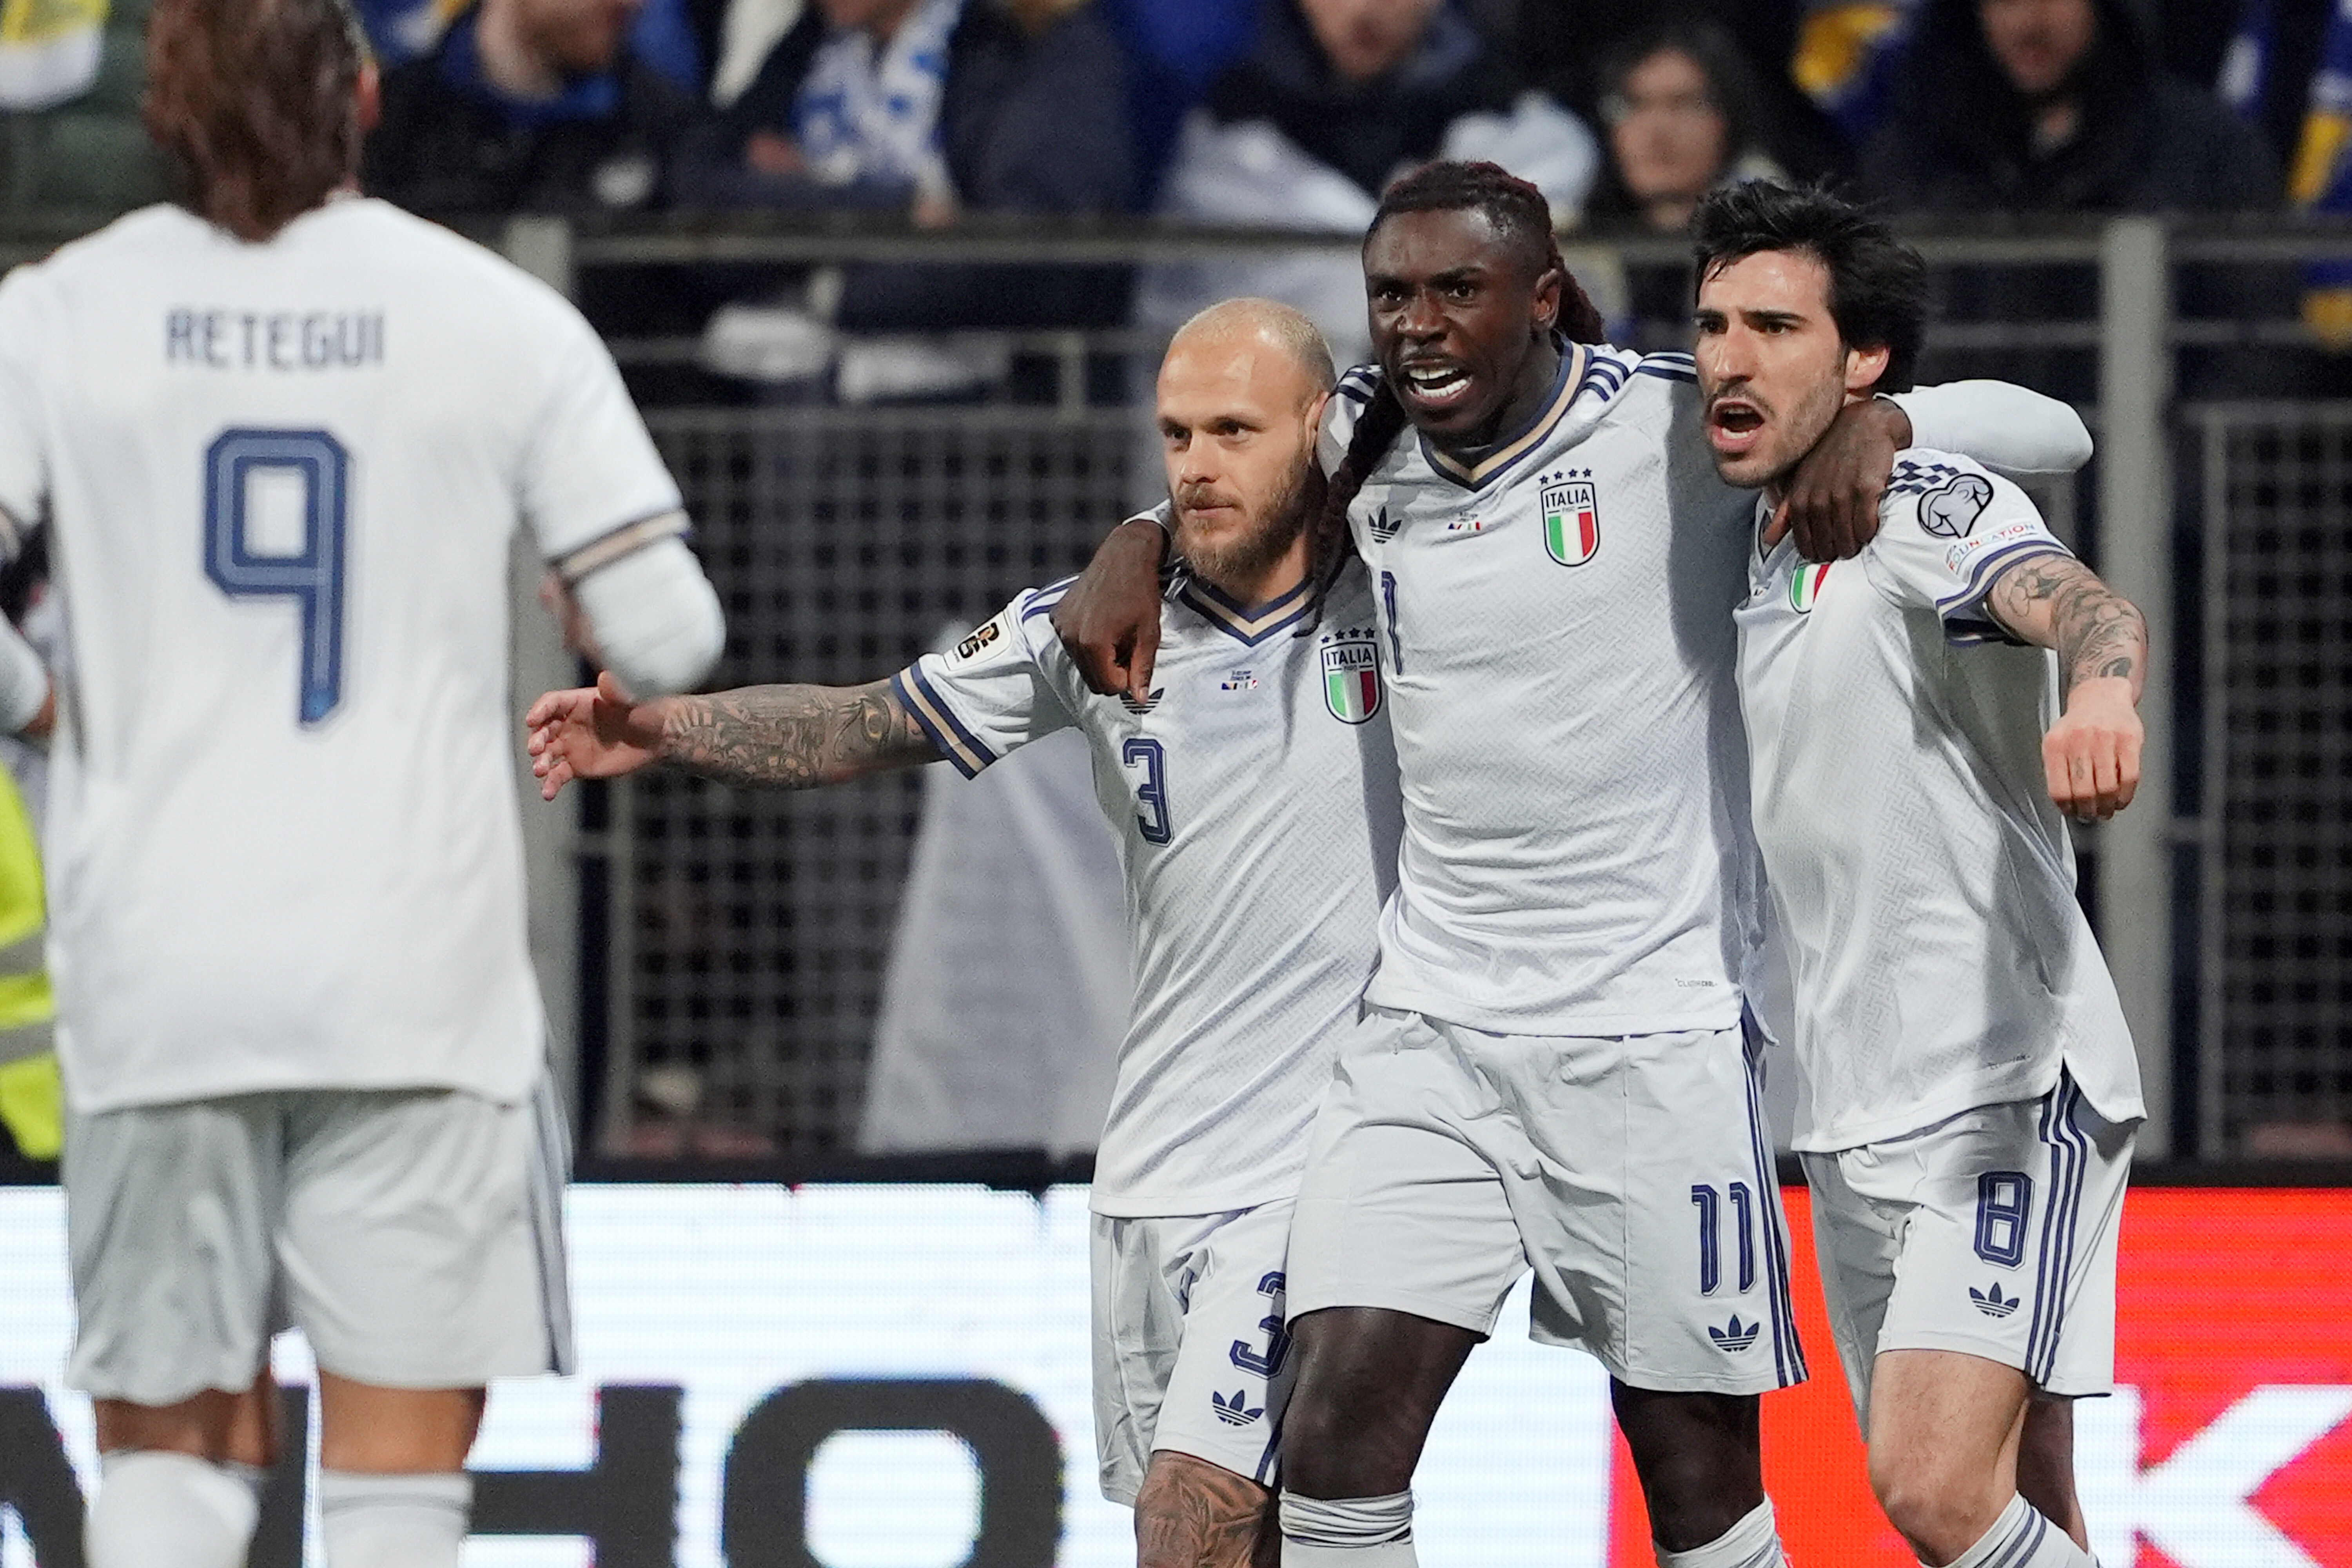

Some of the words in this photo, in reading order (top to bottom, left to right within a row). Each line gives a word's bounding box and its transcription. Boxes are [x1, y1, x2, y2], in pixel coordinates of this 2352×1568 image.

[165, 311, 384, 367] RETEGUI
[1545, 488, 1590, 508] ITALIA
[1948, 524, 2035, 572] FOUNATION
[204, 426, 348, 728] 9
[1326, 648, 1373, 666] ITALIA
[1123, 738, 1174, 848] 3
[1691, 1182, 1758, 1297] 11
[1973, 1171, 2035, 1271] 8
[1229, 1271, 1293, 1380] 3
